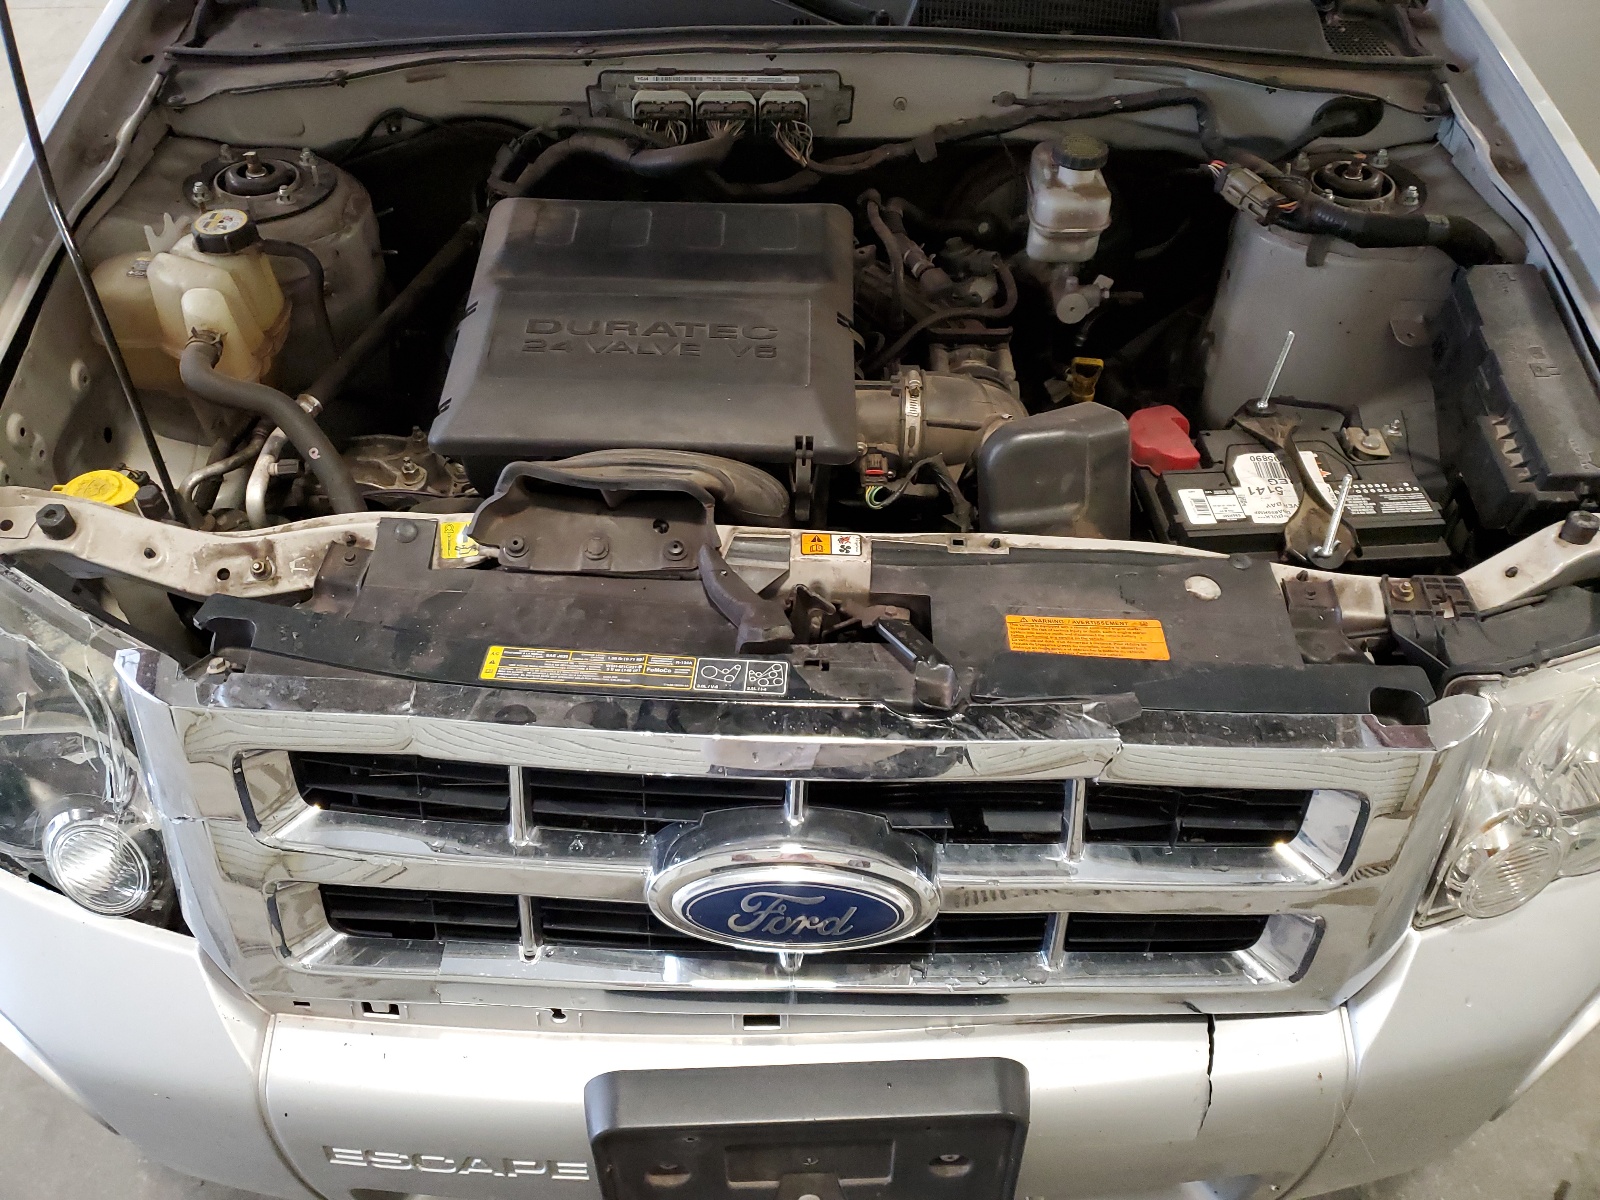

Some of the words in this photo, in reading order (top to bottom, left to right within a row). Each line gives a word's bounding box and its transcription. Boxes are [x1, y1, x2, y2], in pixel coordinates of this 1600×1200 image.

[525, 318, 779, 340] DURATEC
[522, 339, 573, 353] 24
[588, 340, 701, 357] VALVE
[1247, 486, 1284, 496] 5141
[727, 891, 858, 937] Ford
[322, 1145, 590, 1181] ESCAPE
